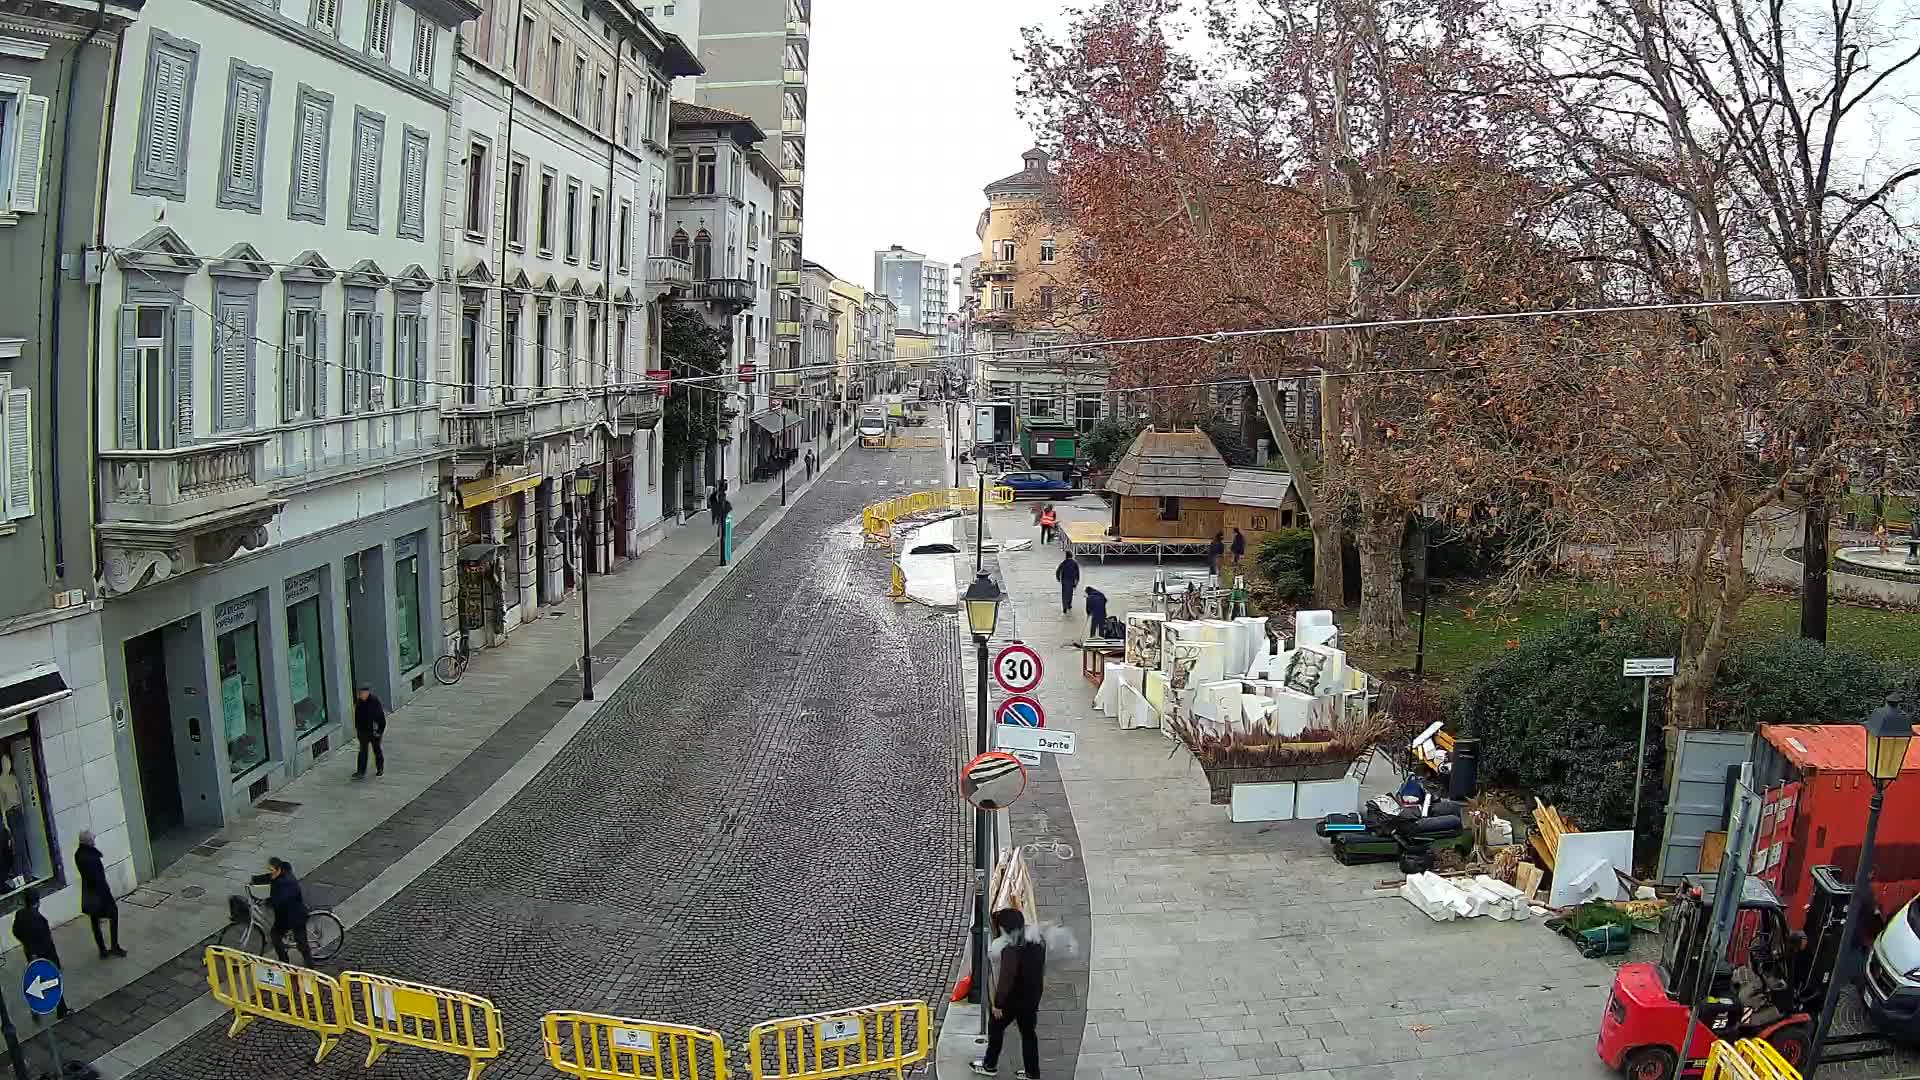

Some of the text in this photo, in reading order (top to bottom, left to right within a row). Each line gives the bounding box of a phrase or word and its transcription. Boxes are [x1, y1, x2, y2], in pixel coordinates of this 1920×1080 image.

[1004, 659, 1032, 680] 30
[1038, 738, 1070, 750] Dante
[1711, 1018, 1728, 1030] 25
